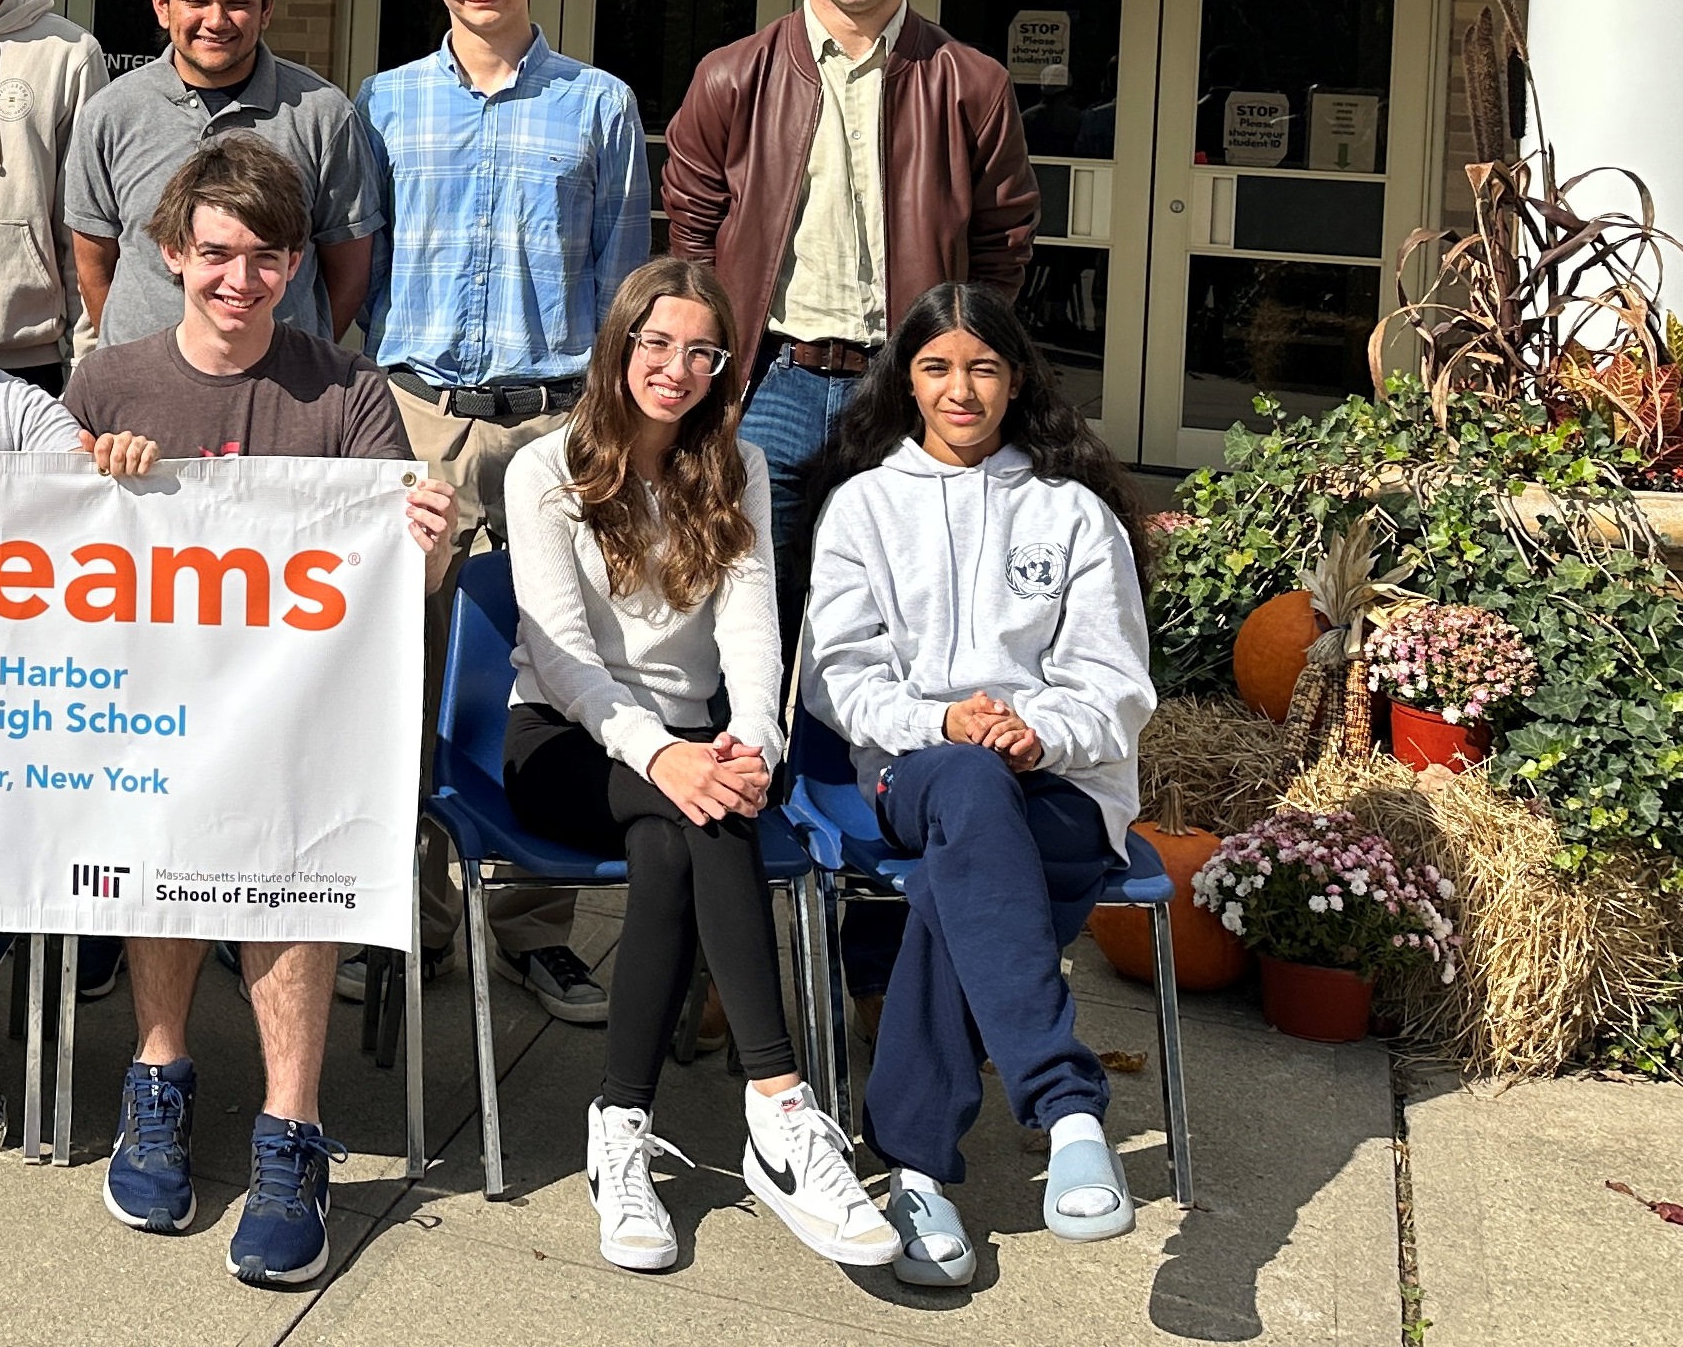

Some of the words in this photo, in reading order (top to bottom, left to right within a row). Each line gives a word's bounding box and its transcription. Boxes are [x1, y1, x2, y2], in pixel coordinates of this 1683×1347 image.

[1020, 23, 1060, 34] STOP
[1022, 36, 1055, 45] Please
[1012, 45, 1039, 54] show
[1042, 48, 1066, 56] your
[102, 53, 156, 69] NTE
[1012, 55, 1050, 64] student
[1052, 56, 1062, 64] ID
[1236, 105, 1279, 117] STOP
[1240, 118, 1275, 128] Please
[1228, 128, 1257, 137] show
[1228, 138, 1268, 148] student
[1270, 139, 1281, 148] ID
[0, 656, 129, 689] Harbor
[65, 703, 186, 737] School
[25, 764, 94, 790] New
[103, 766, 170, 795] York
[156, 868, 236, 883] Massachusetts
[238, 871, 283, 883] Institute
[284, 871, 297, 883] of
[298, 871, 357, 887] Technology
[156, 885, 216, 903] School
[222, 885, 241, 903] of
[246, 887, 356, 909] Engineering
